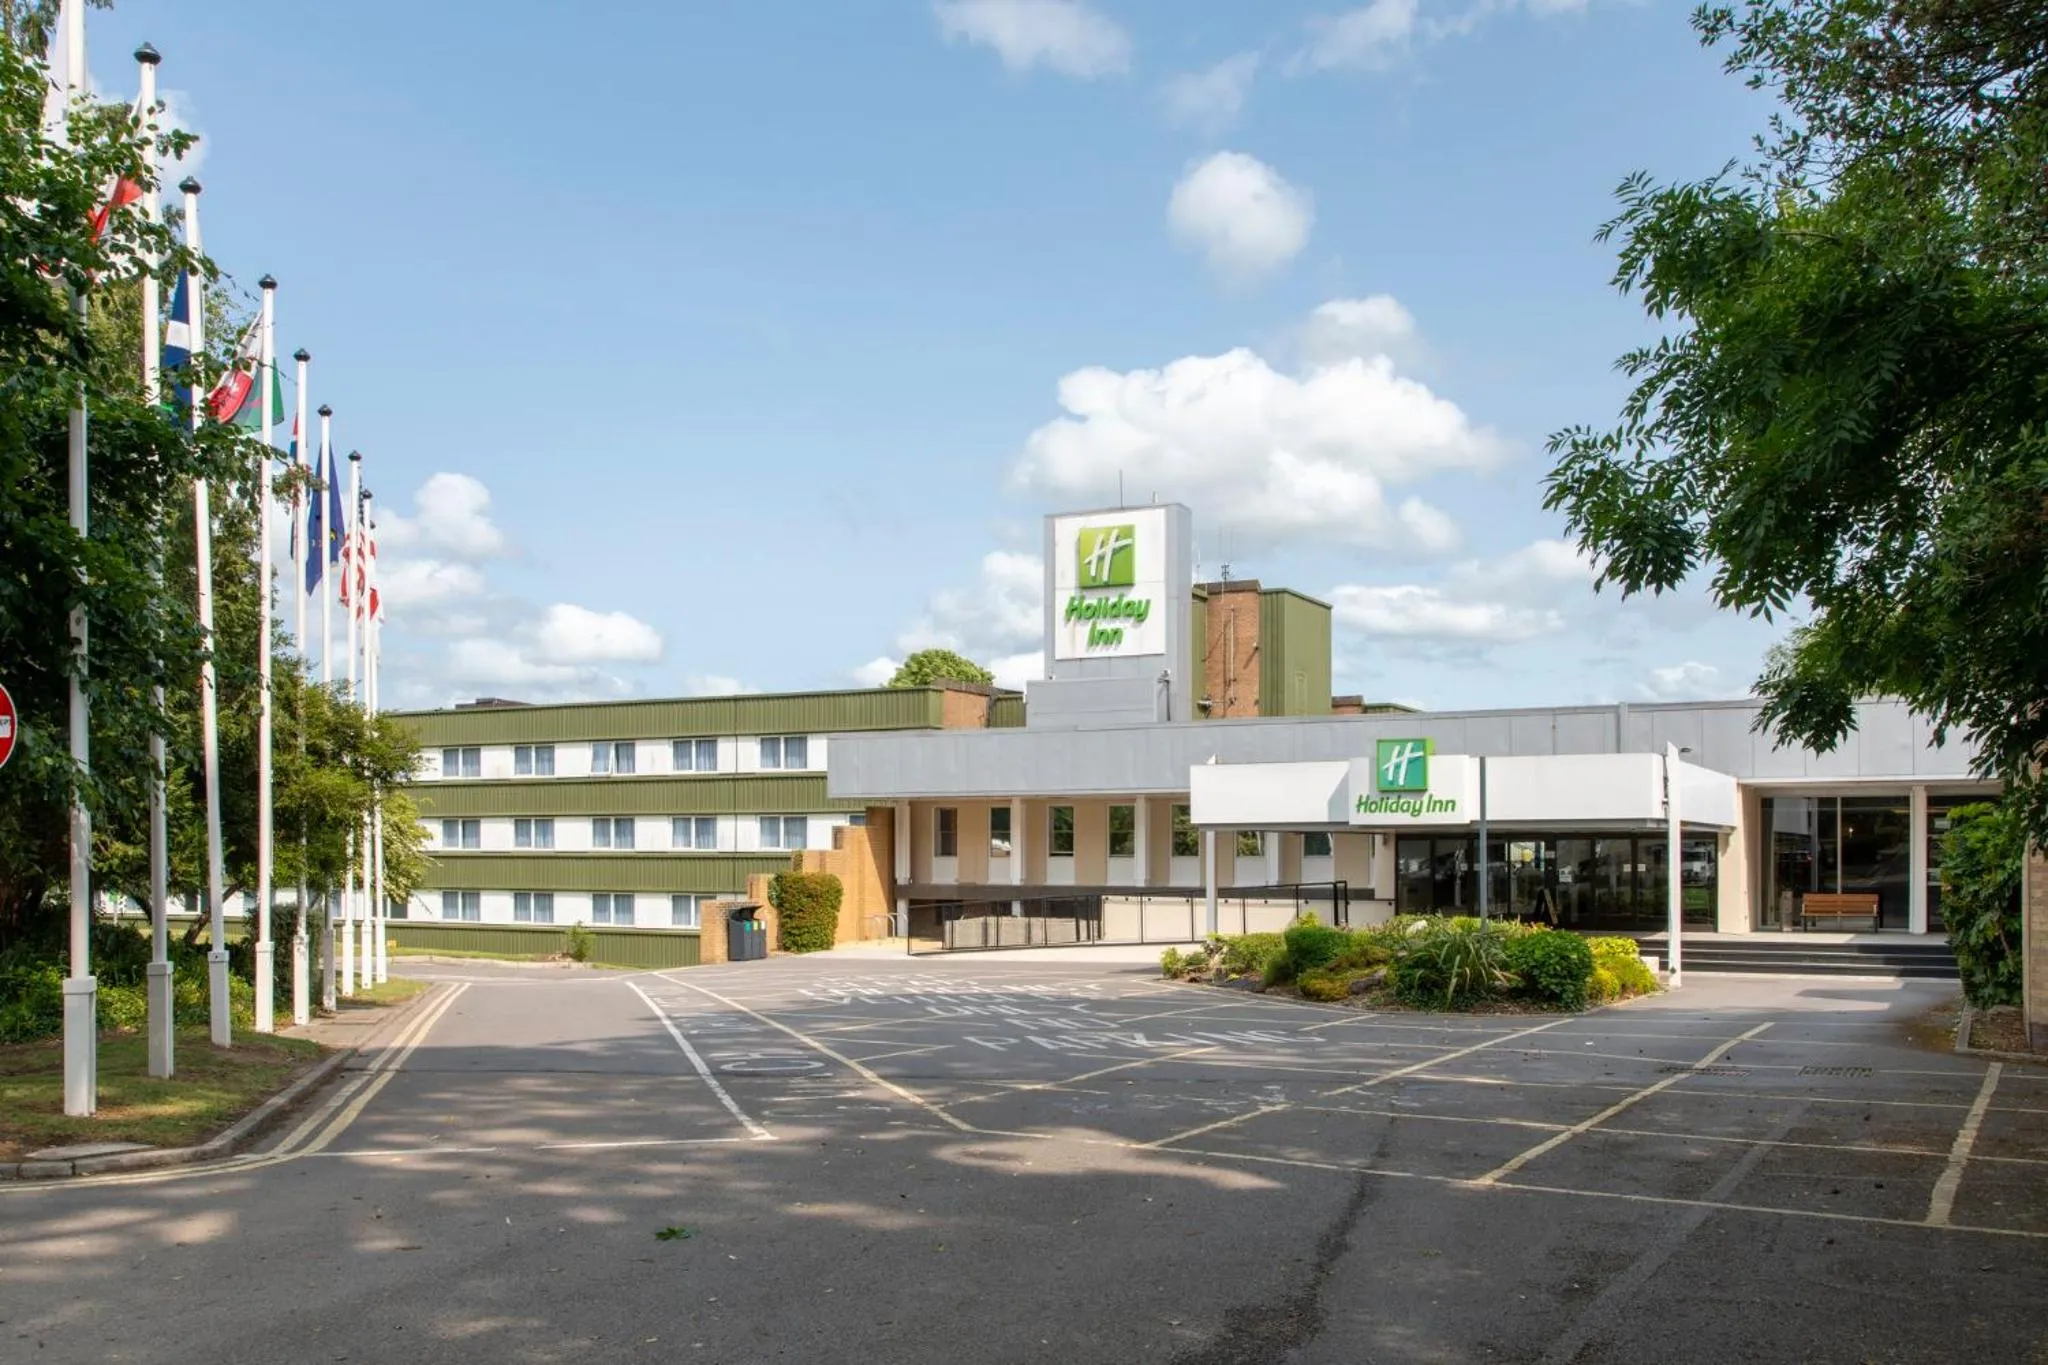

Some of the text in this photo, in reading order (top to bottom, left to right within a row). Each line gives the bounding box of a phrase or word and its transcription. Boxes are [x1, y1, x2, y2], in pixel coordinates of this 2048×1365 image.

[1065, 592, 1150, 624] Holiday
[1088, 619, 1123, 647] Inn
[1356, 794, 1456, 817] Holiday Inn
[926, 1004, 1092, 1016] ONLY
[1002, 1017, 1121, 1030] NO
[963, 1030, 1327, 1051] PARKING
